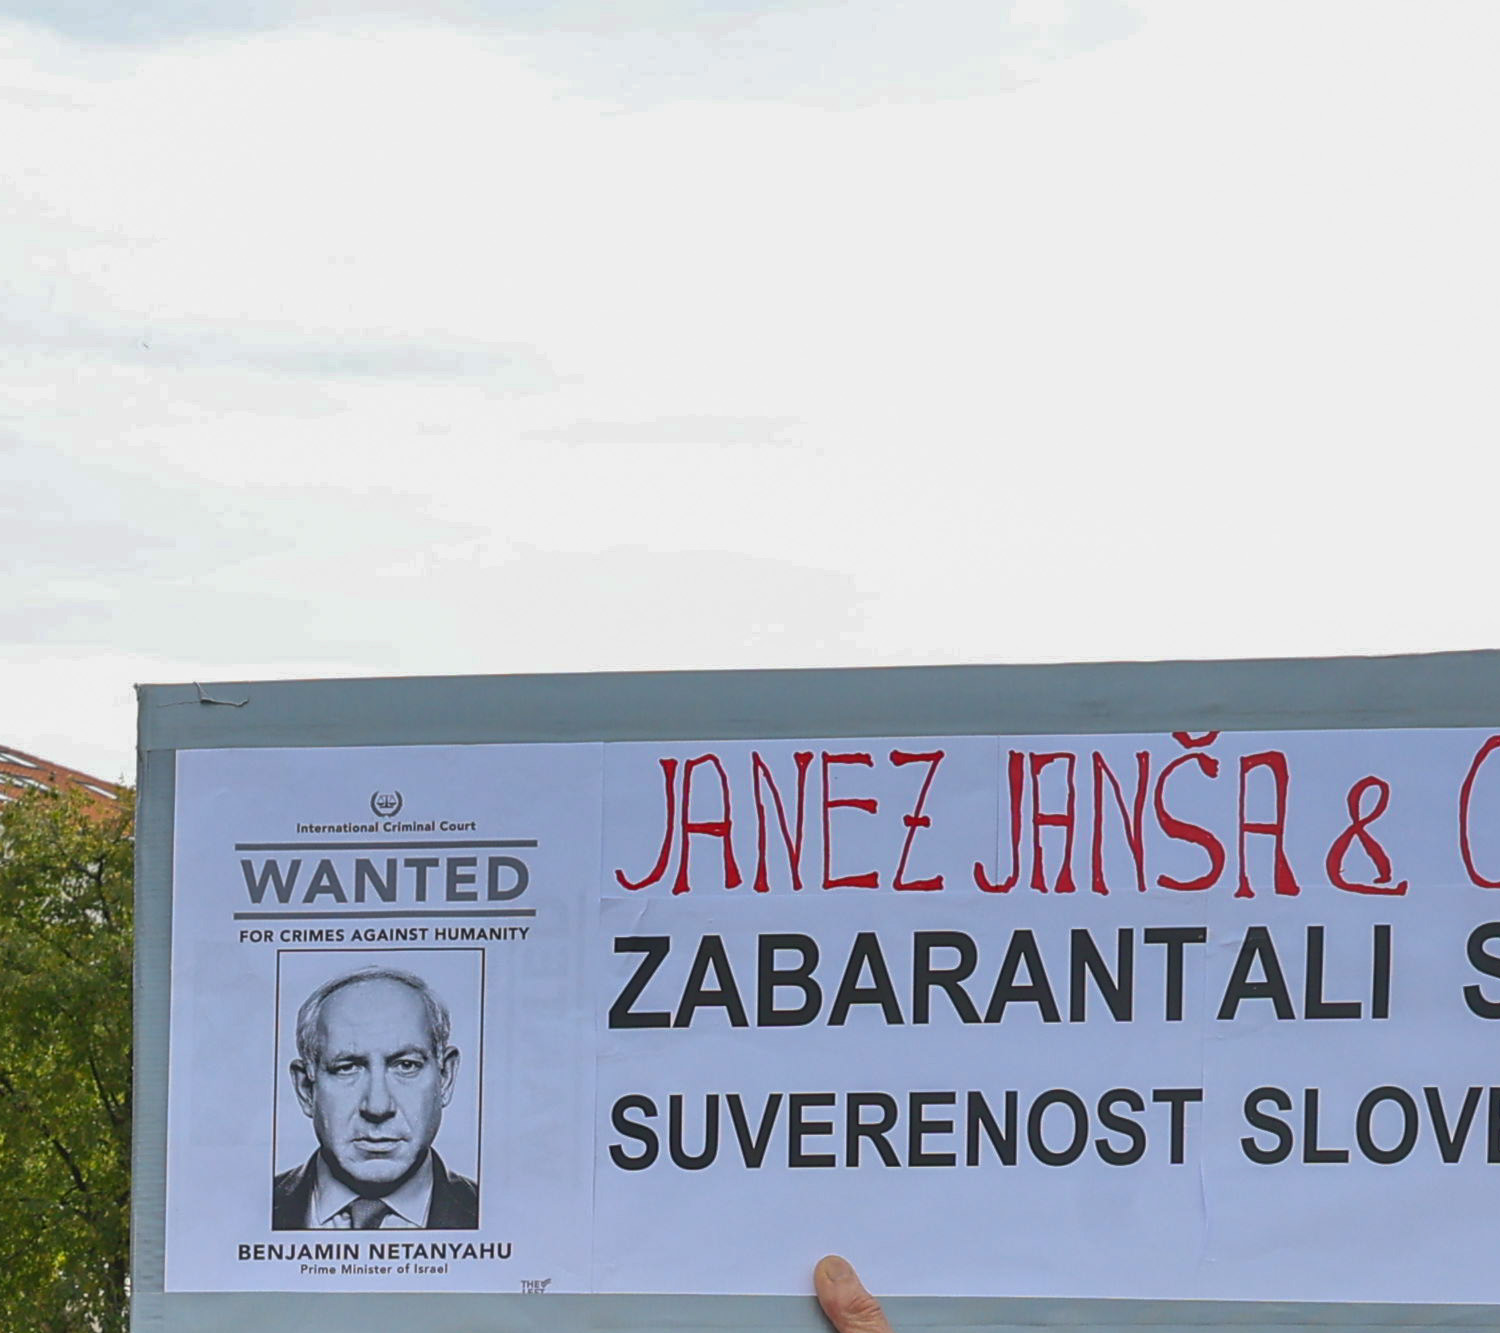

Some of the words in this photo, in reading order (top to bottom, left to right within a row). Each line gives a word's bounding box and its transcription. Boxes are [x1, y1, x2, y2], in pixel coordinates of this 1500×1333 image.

[615, 750, 944, 894] JANEZ
[973, 731, 1300, 899] JANŠA
[1326, 775, 1409, 896] &
[297, 822, 379, 834] International
[383, 820, 436, 833] Criminal
[440, 820, 477, 832] Court
[241, 856, 530, 904] WANTED
[239, 929, 275, 943] FOR
[279, 929, 345, 943] CRIMES
[351, 928, 429, 942] AGAINST
[434, 927, 530, 941] HUMANITY
[607, 923, 1391, 1029] ZABARANTALI
[608, 1088, 1203, 1171] SUVERENOST
[237, 1243, 360, 1261] BENJAMIN
[368, 1243, 512, 1260] NETANYAHU
[300, 1264, 336, 1275] Prime
[341, 1263, 392, 1275] Minister
[397, 1263, 410, 1274] of
[414, 1263, 449, 1274] Israel
[521, 1279, 540, 1289] THE
